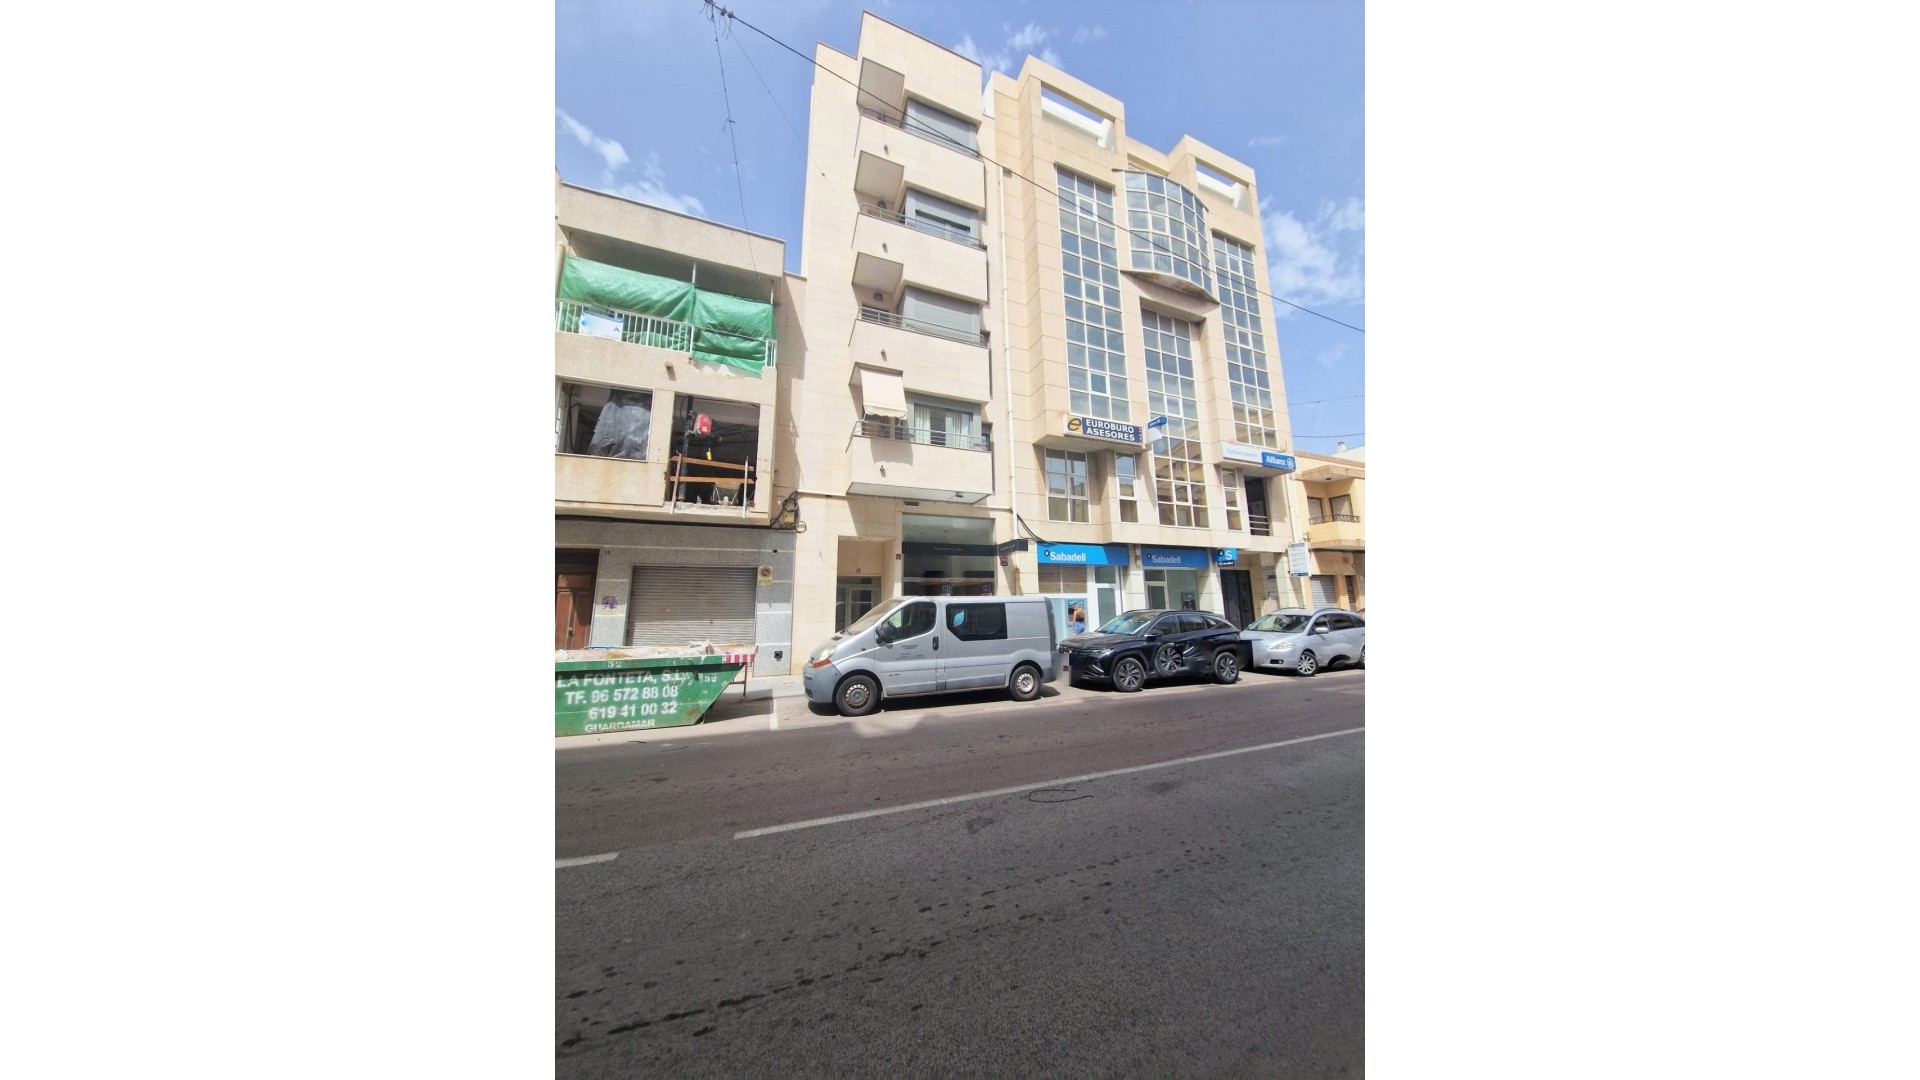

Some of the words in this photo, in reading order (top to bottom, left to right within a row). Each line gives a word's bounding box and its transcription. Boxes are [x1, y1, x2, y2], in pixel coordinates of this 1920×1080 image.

[1086, 419, 1135, 434] EUROBURO
[1086, 427, 1136, 441] ASESORES
[1266, 455, 1287, 466] Allianz
[1050, 551, 1087, 562] Sabadell
[1151, 555, 1182, 564] Sabadell
[1225, 550, 1233, 560] S
[557, 675, 580, 688] LA
[583, 670, 657, 686] FONTETA,
[564, 691, 587, 704] TF.
[591, 689, 609, 703] 96
[613, 687, 639, 702] 572
[642, 686, 659, 699] 88
[662, 684, 679, 698] 08
[589, 705, 617, 720] 619
[619, 704, 636, 717] 41
[641, 702, 657, 716] 00
[660, 700, 678, 714] 32
[584, 718, 656, 733] GUARDAMAR
